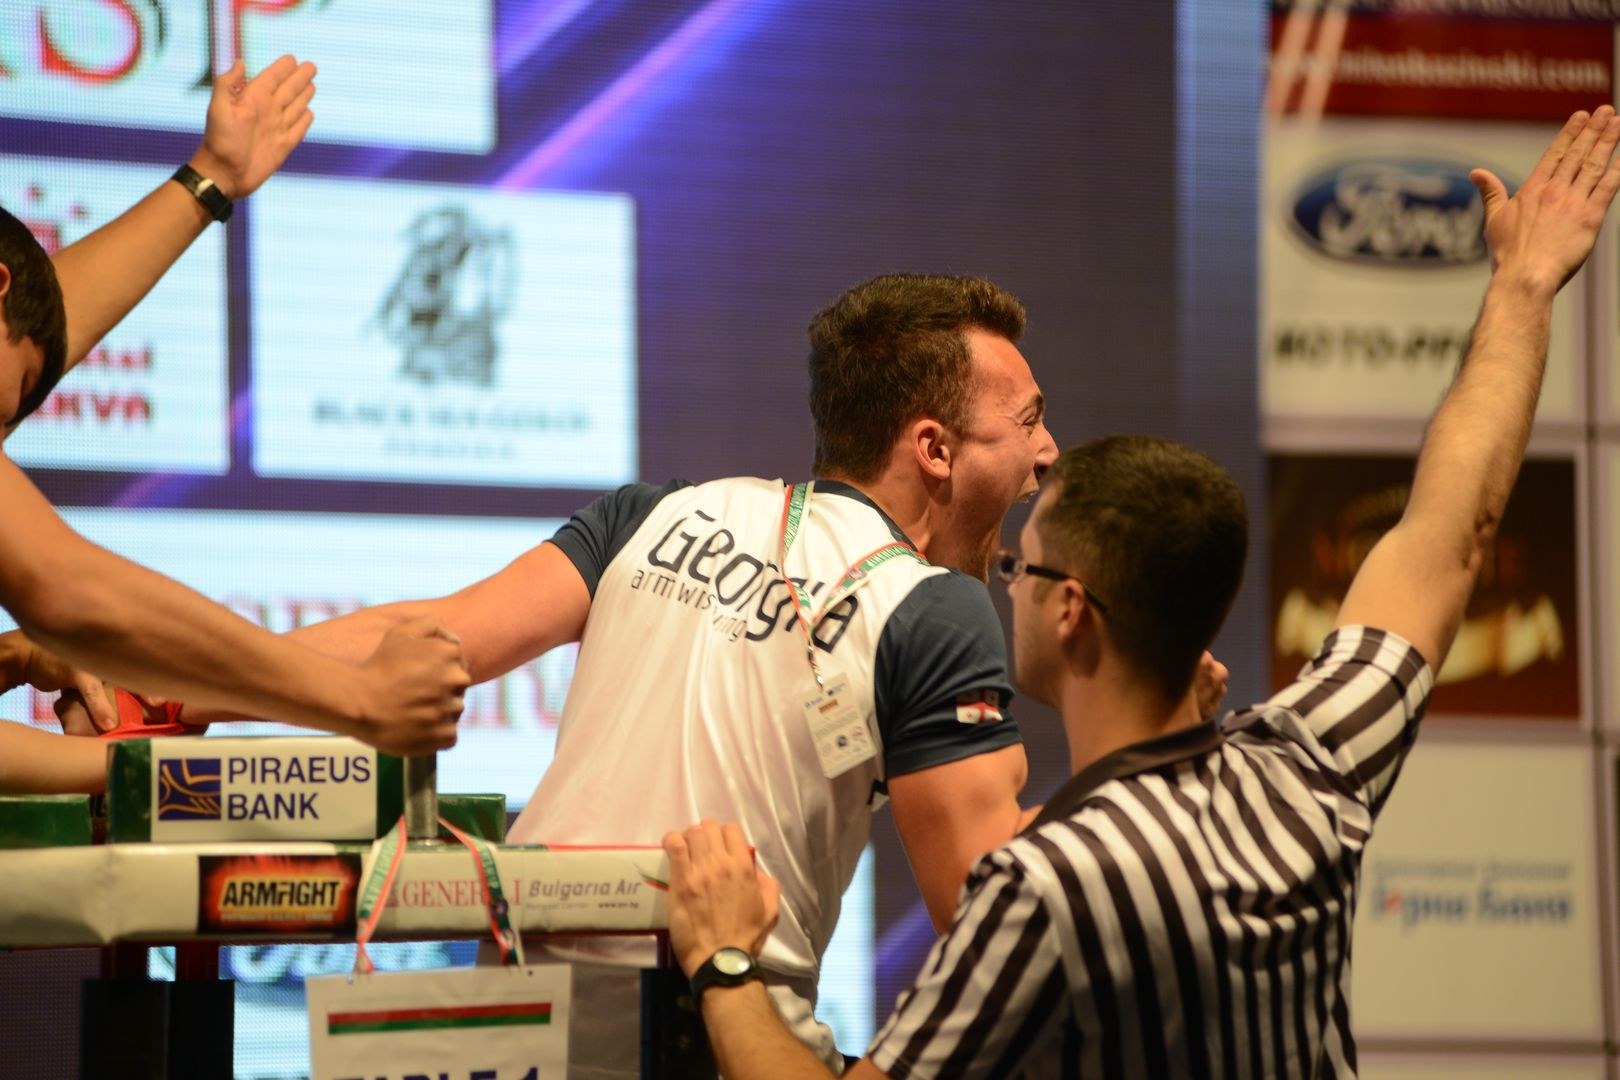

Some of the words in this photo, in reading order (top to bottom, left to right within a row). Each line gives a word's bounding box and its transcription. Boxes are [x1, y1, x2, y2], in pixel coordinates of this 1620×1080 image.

[227, 756, 371, 784] PIRAEUS
[227, 793, 320, 820] BANK
[222, 880, 341, 907] ARMFIGHT
[401, 878, 521, 908] GENERI
[528, 878, 611, 901] Bulgaria
[617, 879, 642, 896] Air
